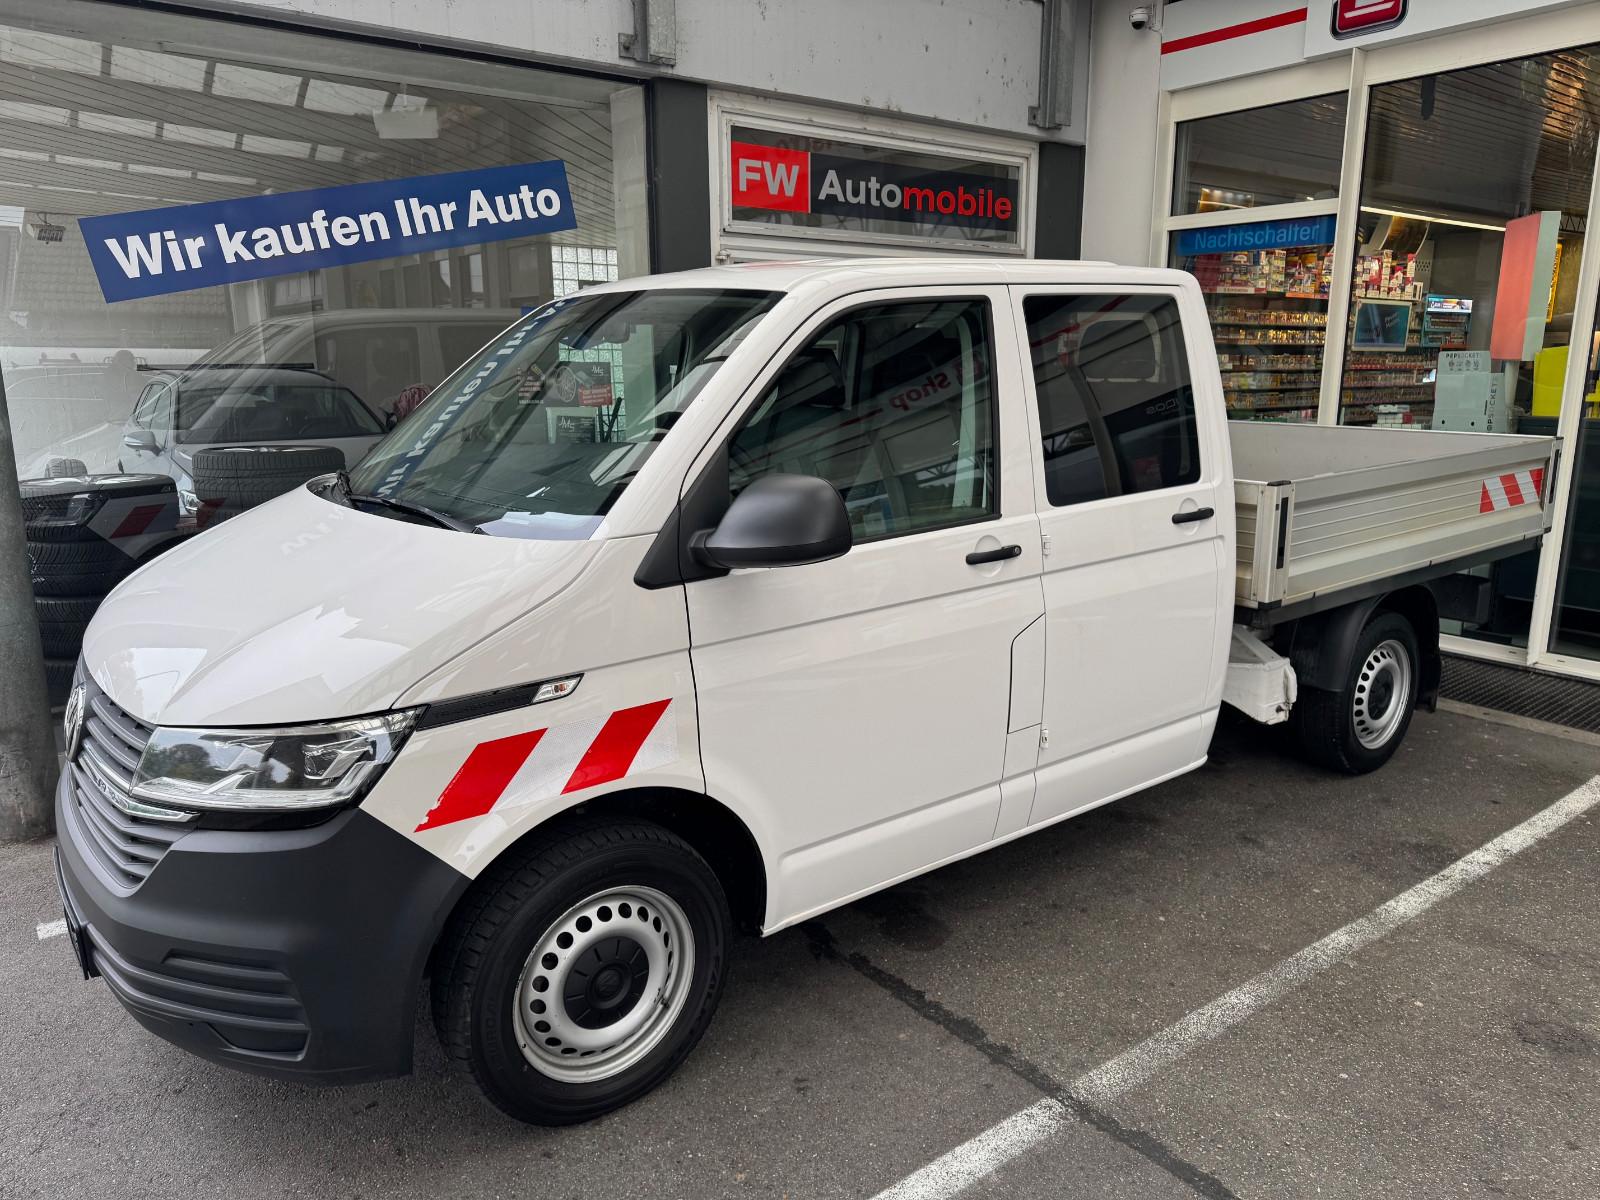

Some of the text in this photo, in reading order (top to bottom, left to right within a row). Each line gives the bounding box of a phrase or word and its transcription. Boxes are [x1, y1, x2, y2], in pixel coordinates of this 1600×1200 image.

[738, 158, 1013, 220] FW Automobile
[104, 184, 561, 279] Wir kaufen Ihr Auto
[1194, 223, 1320, 250] Nachtschalter
